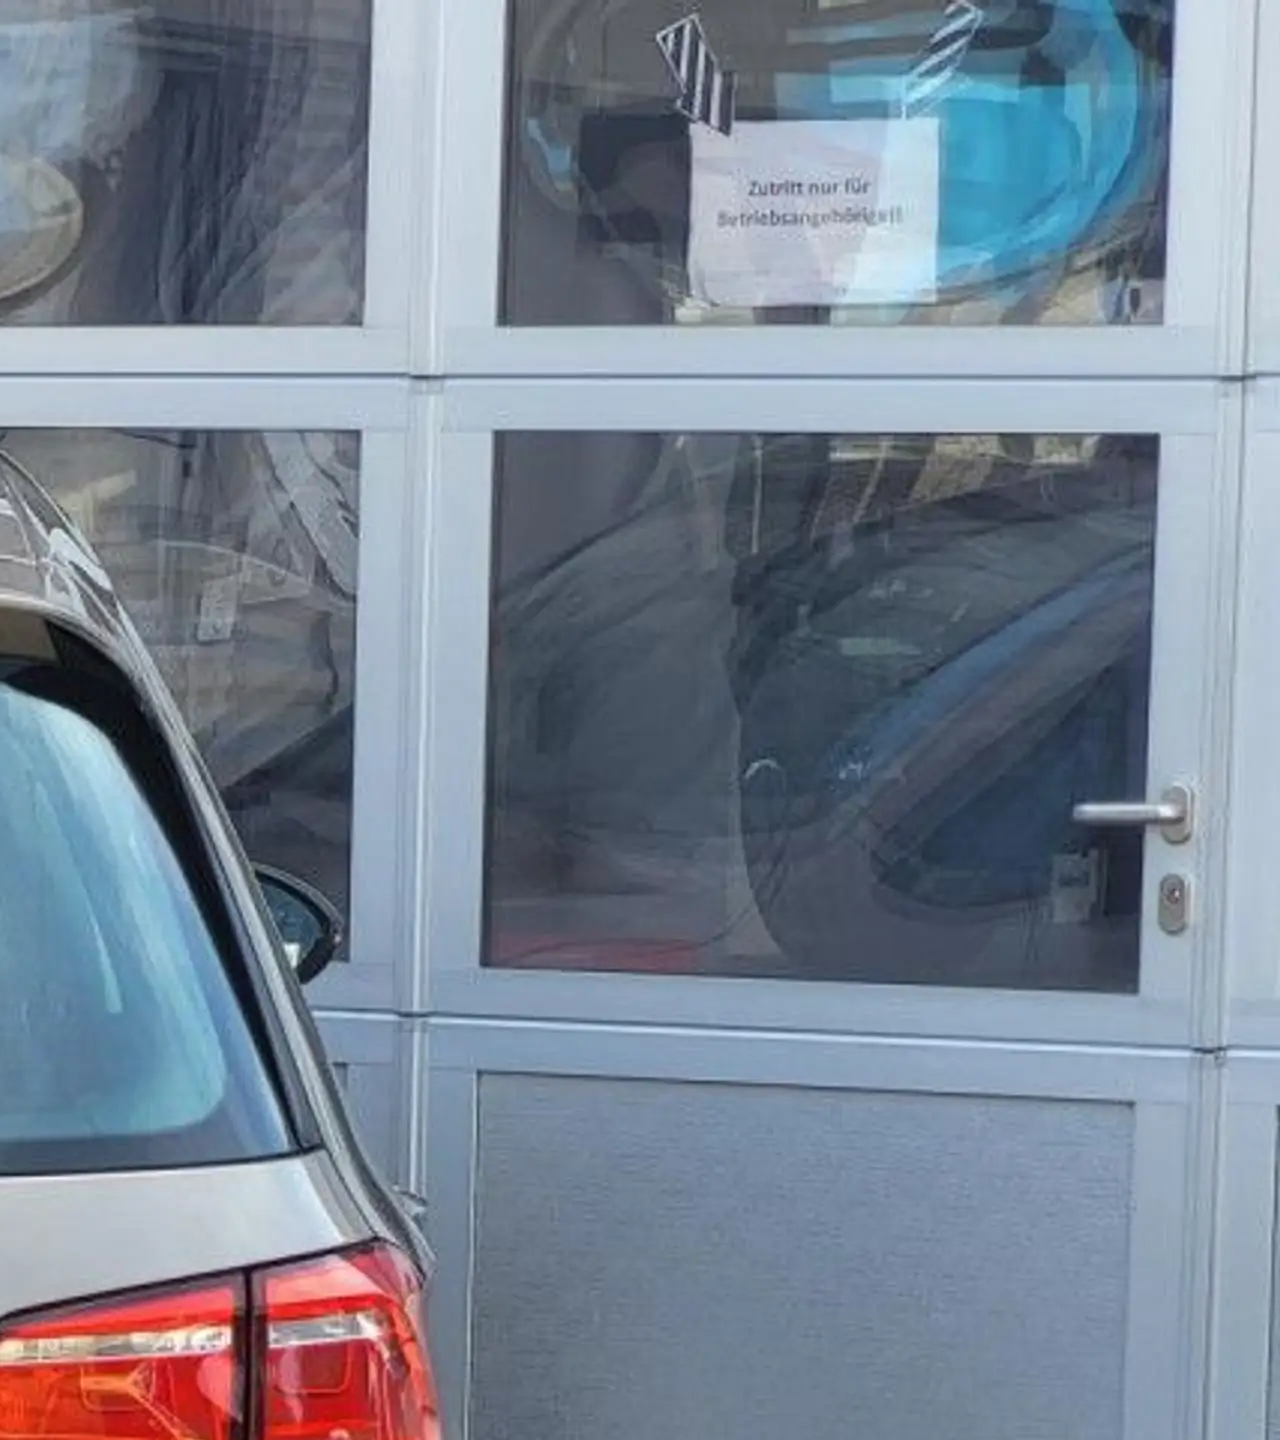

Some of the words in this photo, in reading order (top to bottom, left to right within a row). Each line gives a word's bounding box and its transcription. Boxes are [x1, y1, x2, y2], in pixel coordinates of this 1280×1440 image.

[748, 179, 803, 197] Zutritt
[808, 181, 839, 196] nur
[845, 176, 872, 195] für
